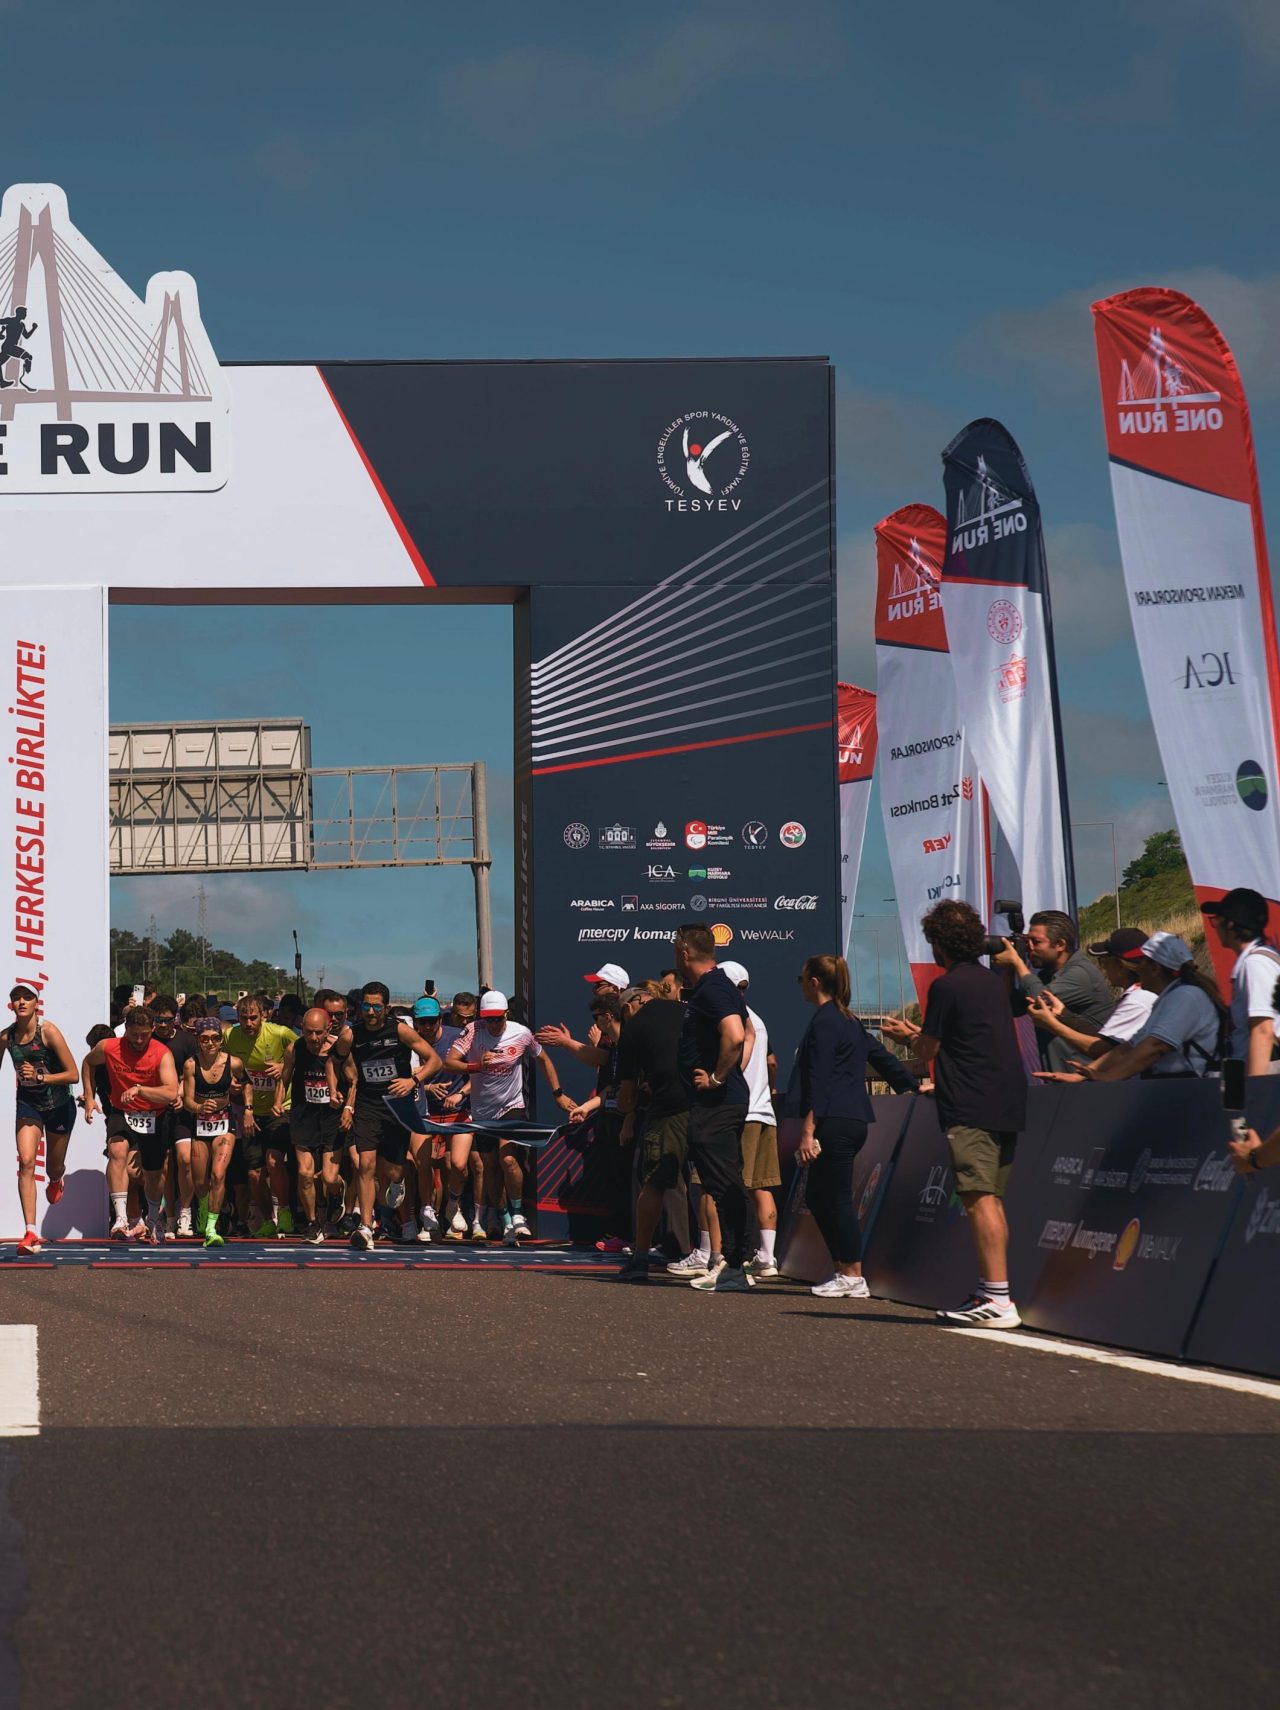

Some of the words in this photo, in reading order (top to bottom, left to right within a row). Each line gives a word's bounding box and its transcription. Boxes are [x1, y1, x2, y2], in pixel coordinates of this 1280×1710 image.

[684, 410, 709, 422] SPOR
[711, 411, 740, 434] YARDIM
[737, 432, 747, 445] VE
[40, 421, 212, 475] RUN
[664, 499, 741, 512] TESYEV
[8, 639, 46, 793] BİRLİKTE!
[838, 751, 864, 765] UN
[648, 864, 676, 878] ICA
[15, 797, 45, 962] HERKESLE
[570, 899, 615, 907] ARABICA
[656, 902, 686, 910] SİGORTA
[578, 928, 630, 942] intercity
[633, 926, 677, 944] komag
[740, 929, 795, 941] WeWALK
[366, 1066, 393, 1078] 5123
[307, 1088, 330, 1098] 1206
[128, 1116, 152, 1129] 5035
[201, 1120, 226, 1132] 1971
